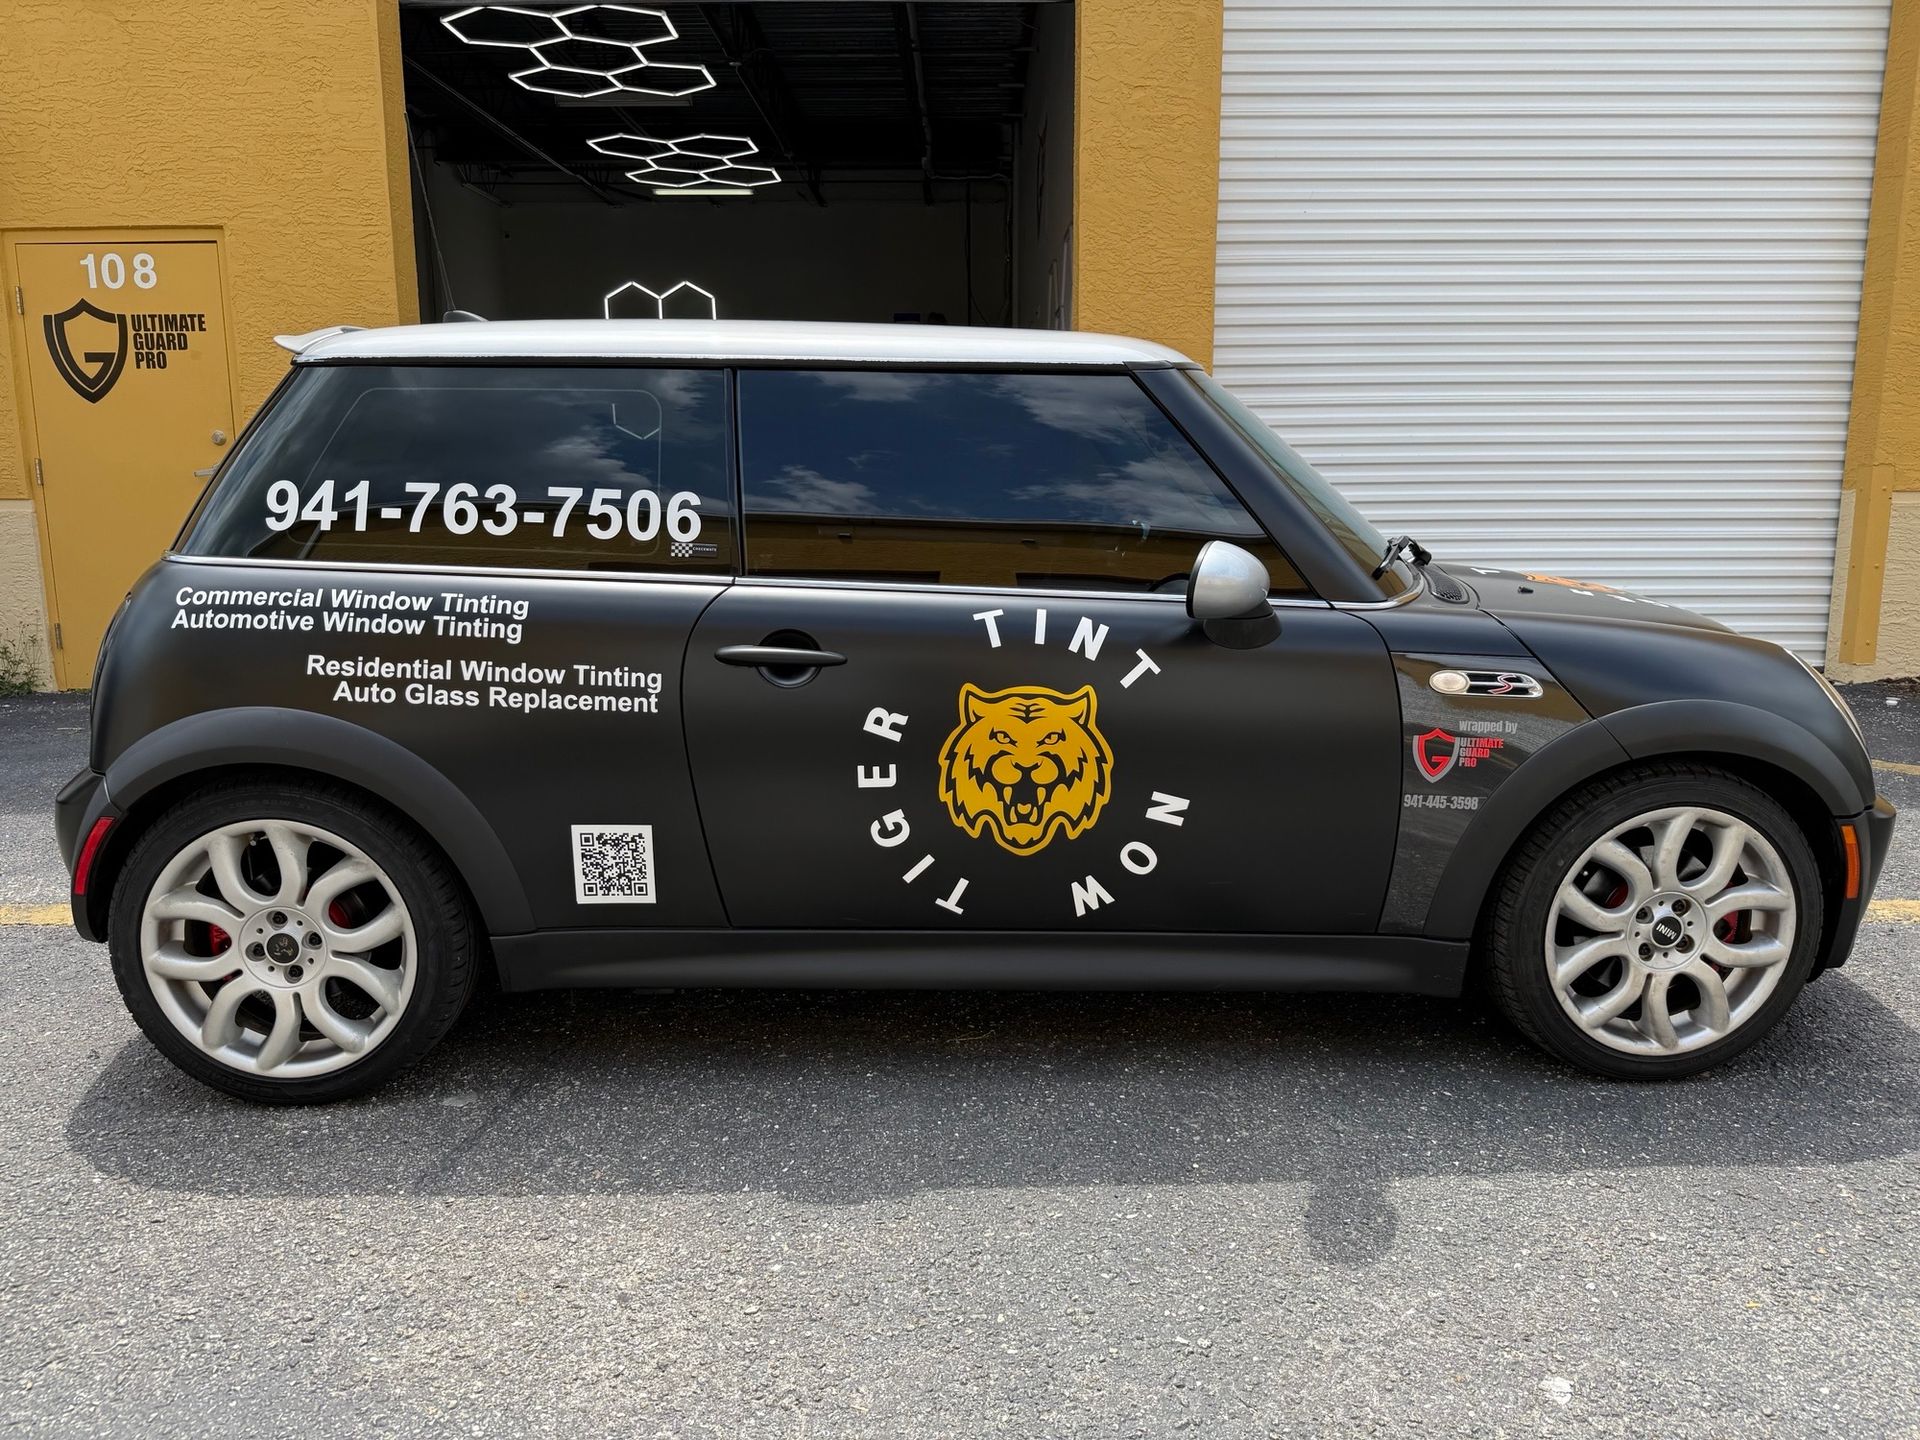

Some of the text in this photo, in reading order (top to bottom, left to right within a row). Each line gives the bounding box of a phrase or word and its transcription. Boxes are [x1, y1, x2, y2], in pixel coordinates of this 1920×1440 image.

[80, 253, 157, 289] 108
[131, 314, 206, 332] ULTIMATE
[133, 333, 188, 351] GUARD
[135, 351, 167, 369] PRO
[265, 480, 702, 543] 941-763-7506
[175, 587, 529, 620] Commercial Window Tinting
[171, 609, 522, 644] Automotive Window Tinting
[306, 655, 662, 695] Residential Window Tinting
[333, 681, 658, 713] Auto Glass Replacement
[1459, 720, 1518, 734] wrapped by
[1459, 737, 1504, 748] ULTIMATE
[857, 706, 969, 915] TIGER
[973, 609, 1161, 689] TINT
[1459, 748, 1490, 758] GUARD
[1459, 758, 1477, 767] PRO
[1403, 794, 1479, 810] 941-445-3598
[1656, 923, 1677, 940] MINI
